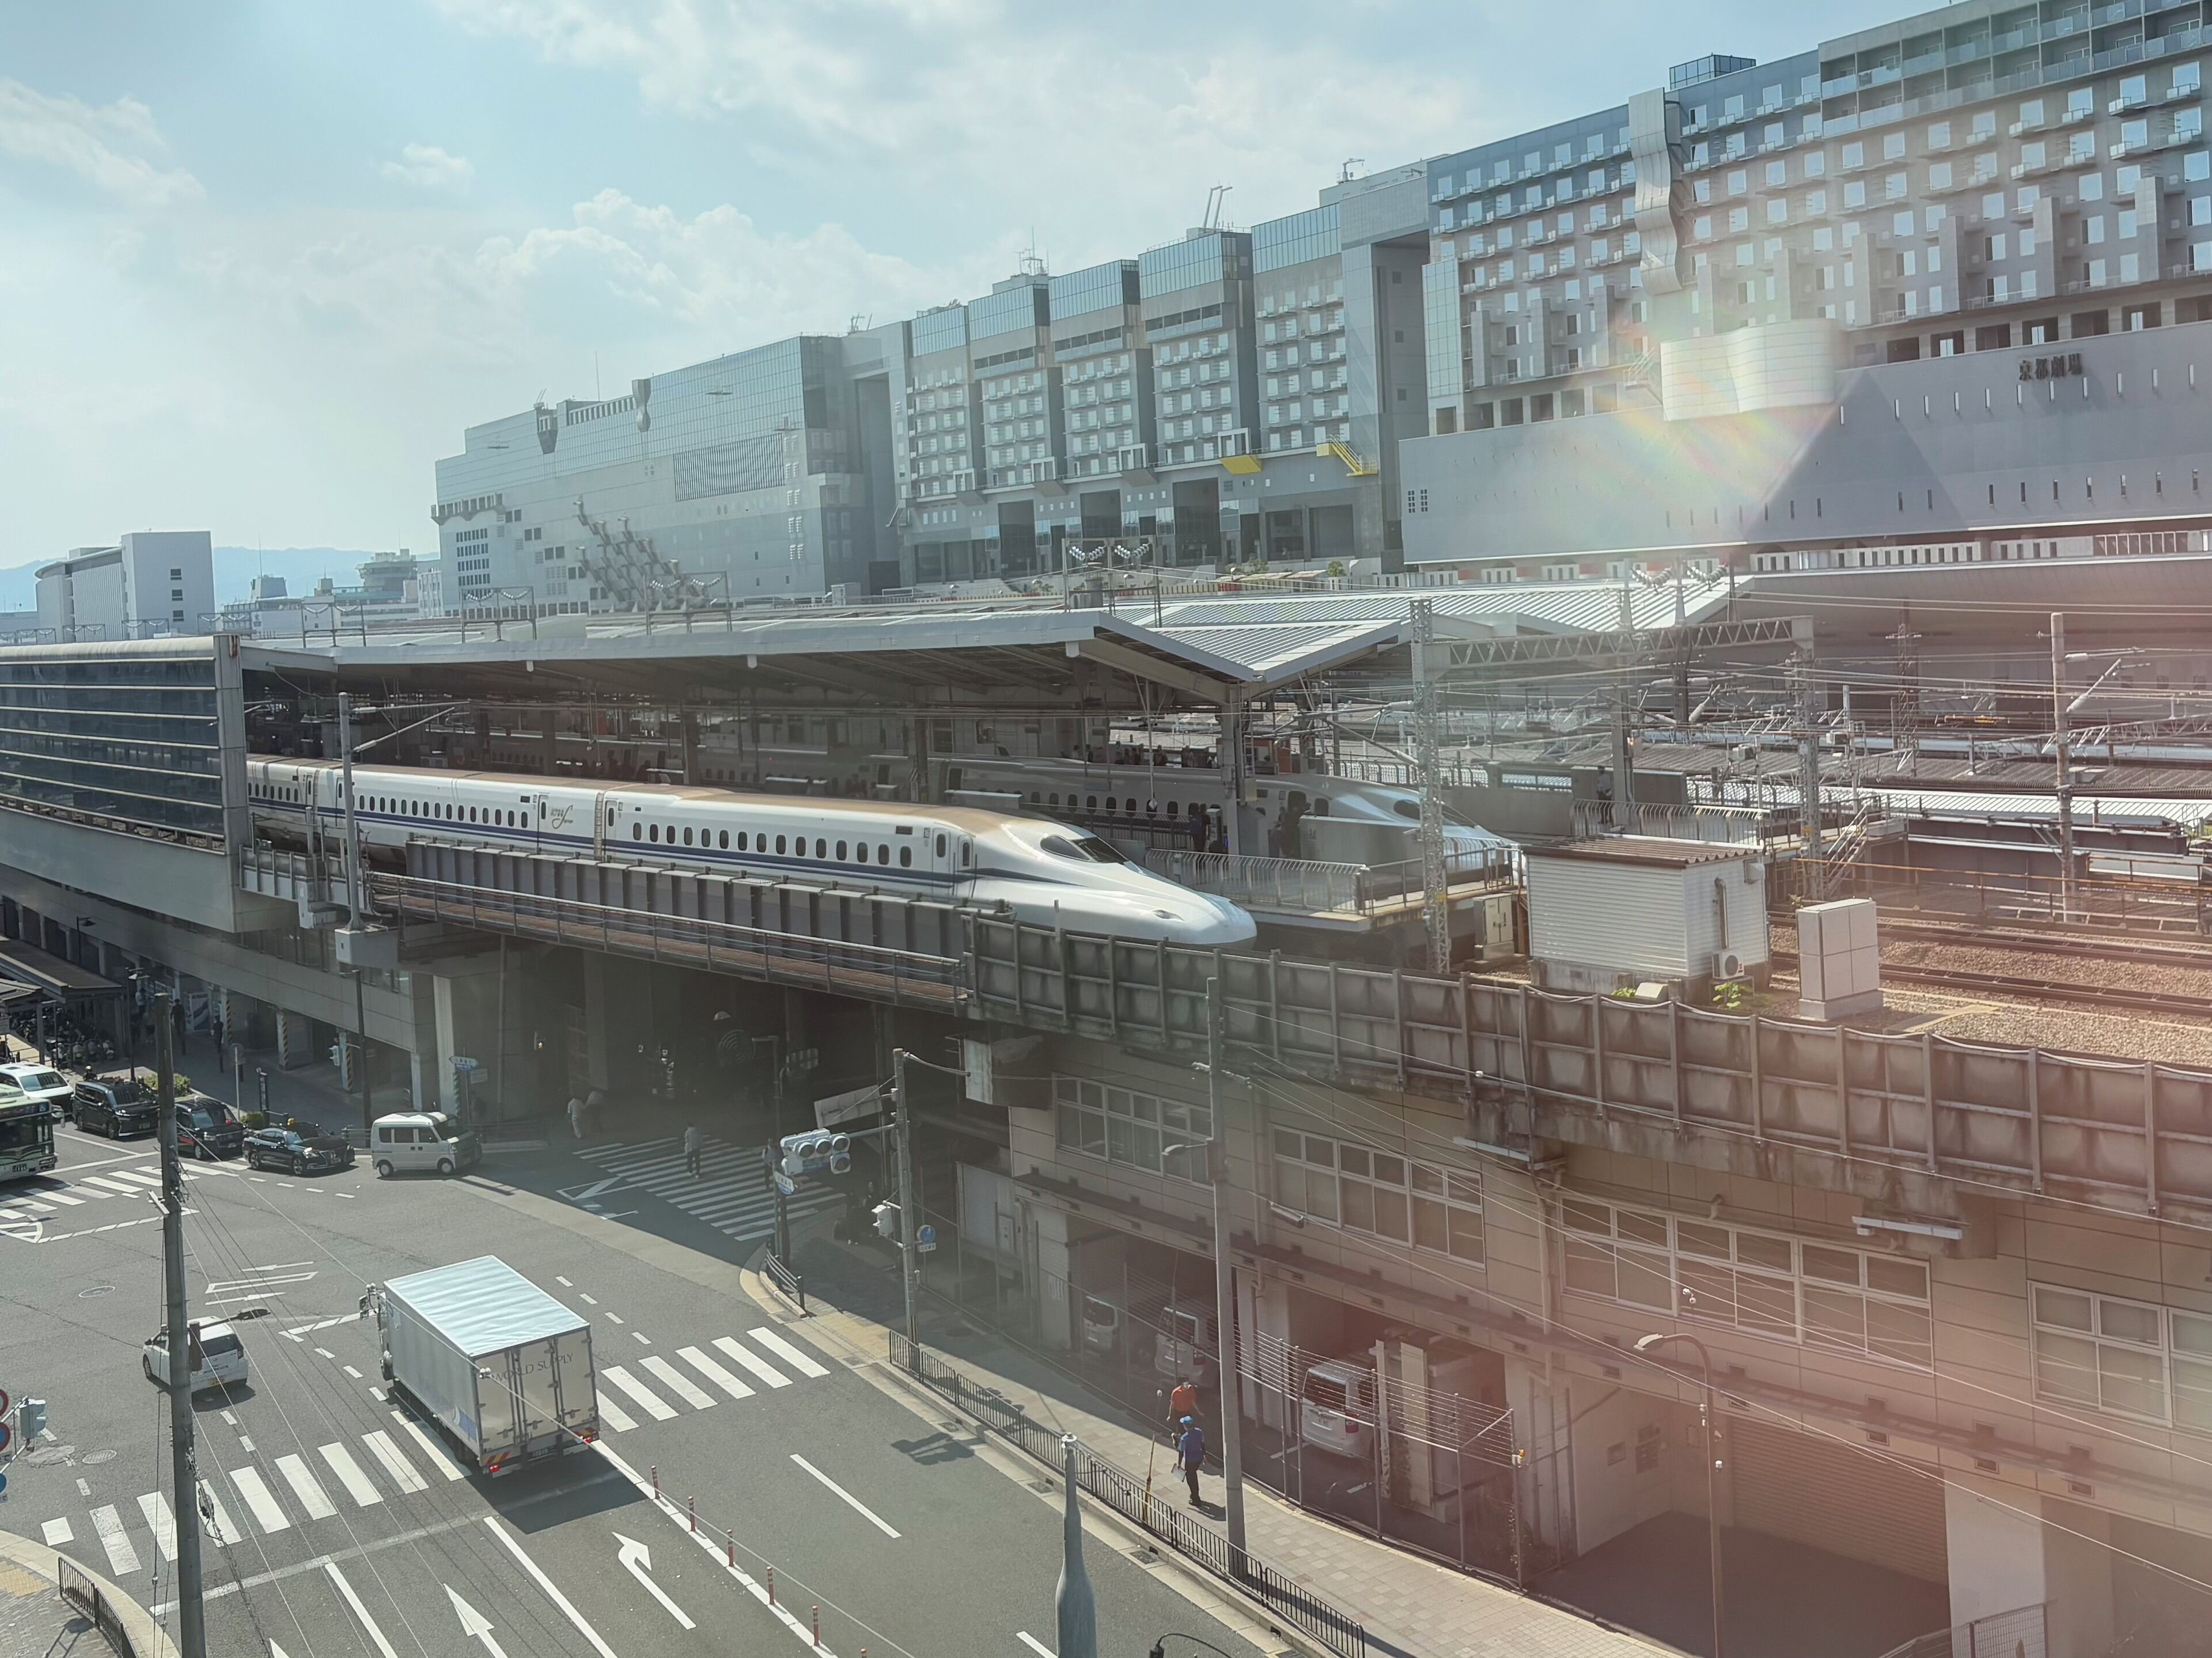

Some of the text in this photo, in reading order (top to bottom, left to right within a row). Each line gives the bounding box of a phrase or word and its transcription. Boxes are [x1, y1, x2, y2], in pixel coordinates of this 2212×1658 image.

[2018, 352, 2083, 381] 京都劇場
[537, 1353, 574, 1371] SUPLY
